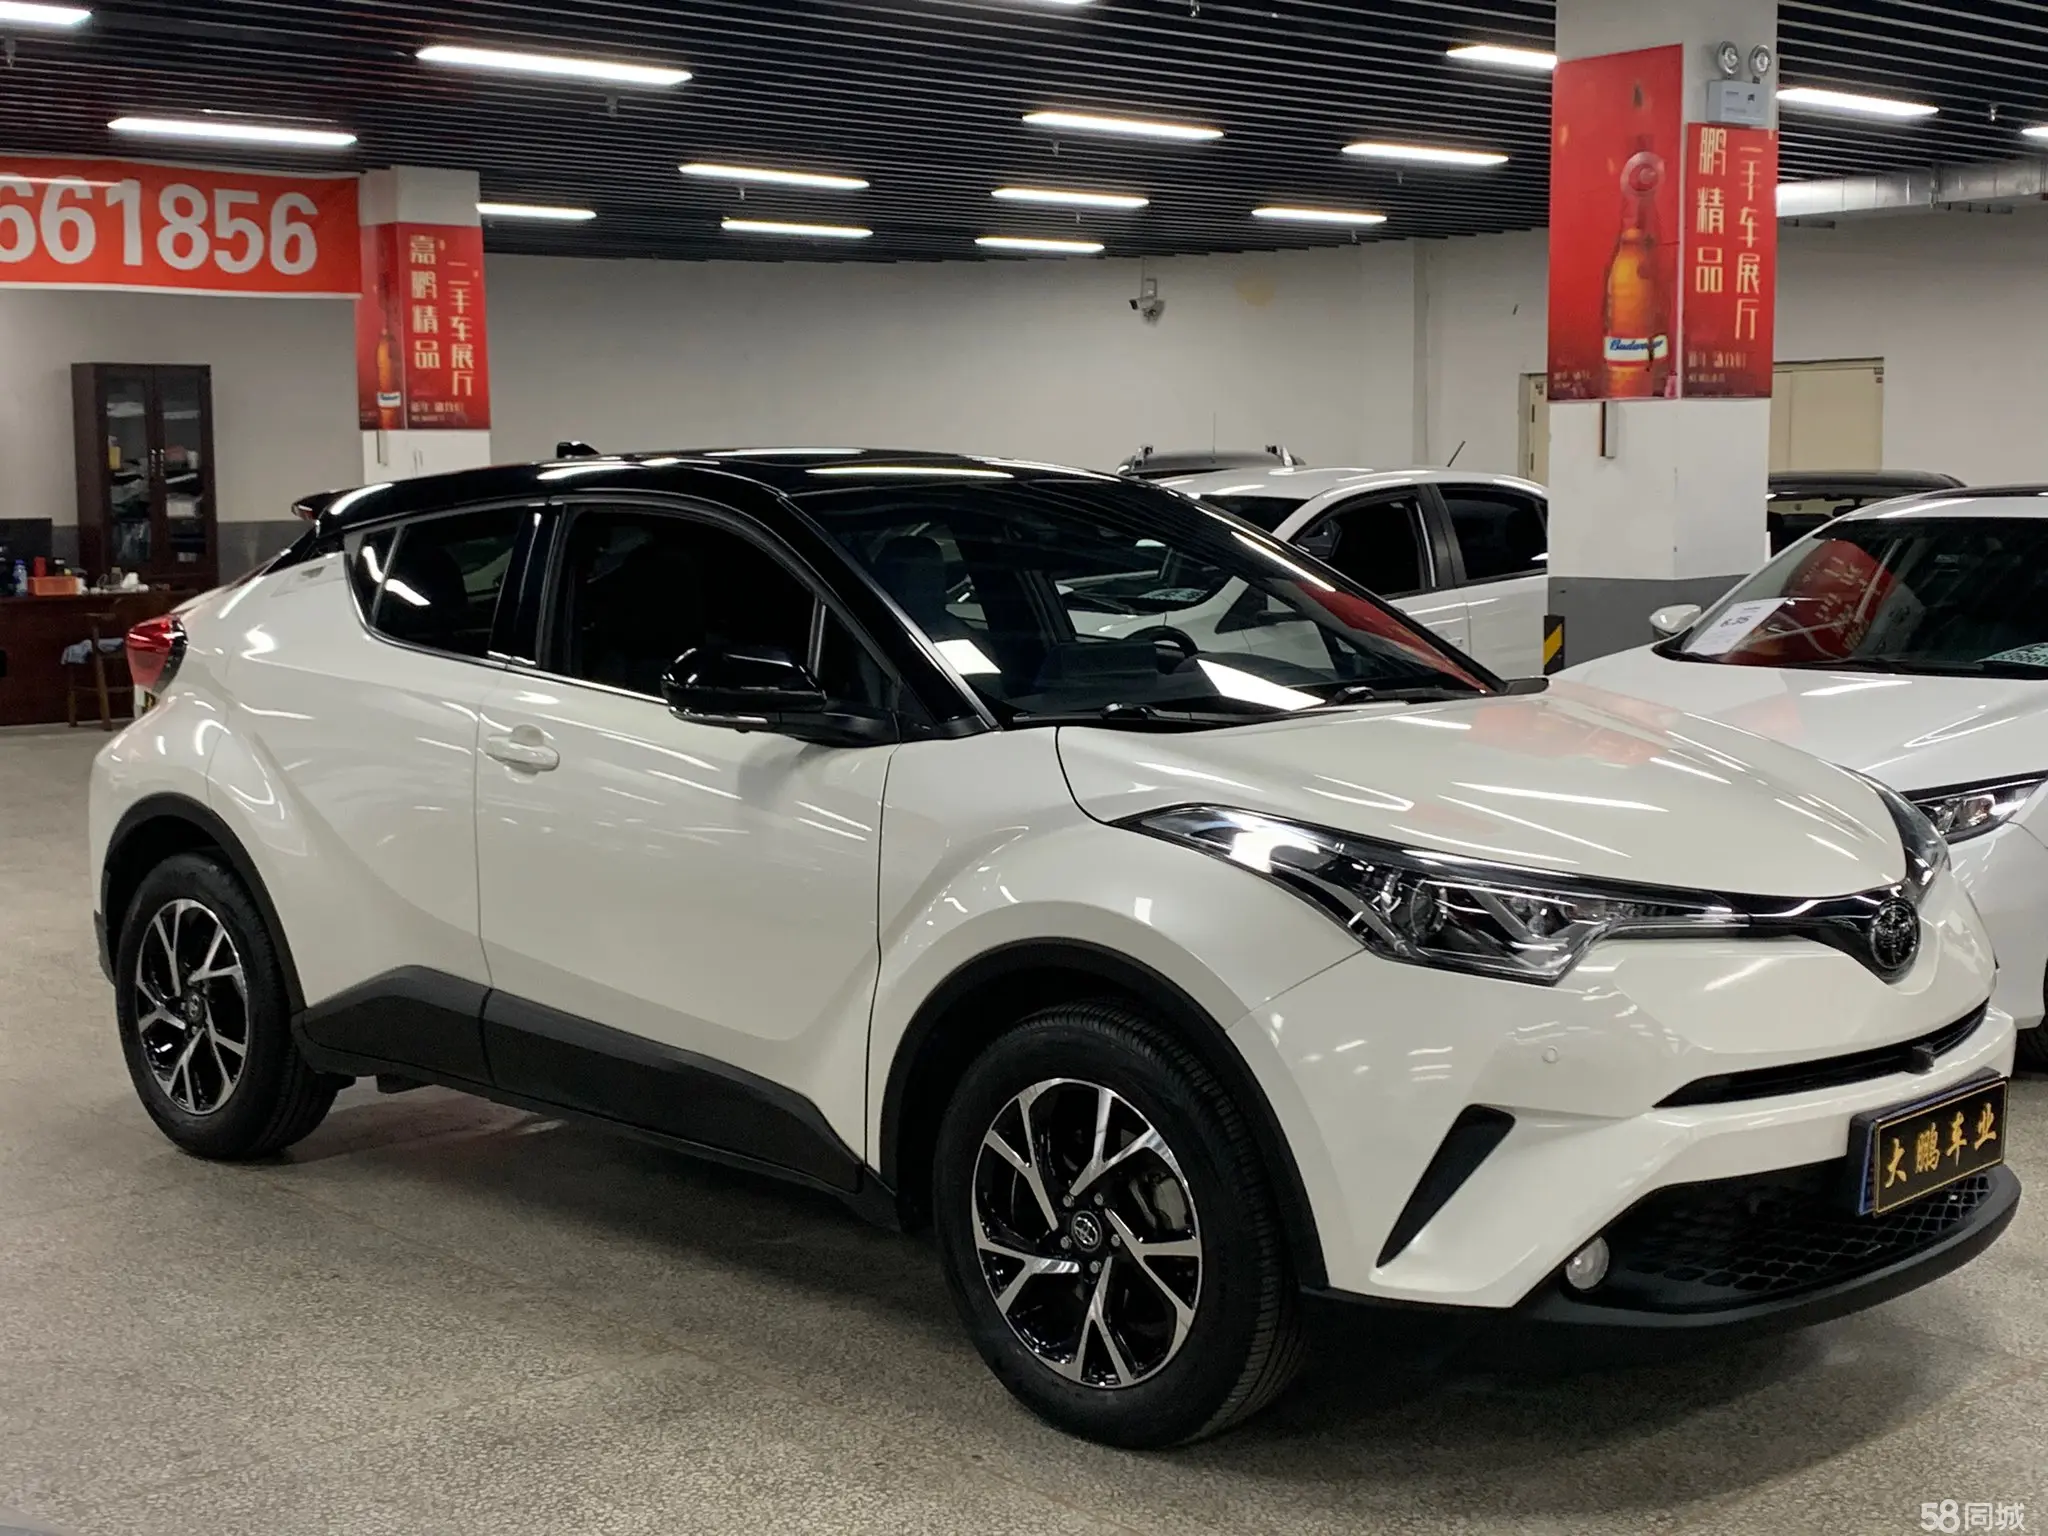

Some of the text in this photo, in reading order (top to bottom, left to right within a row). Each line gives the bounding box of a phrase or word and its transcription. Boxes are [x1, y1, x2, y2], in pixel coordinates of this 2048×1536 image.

[0, 172, 319, 275] 661856
[410, 235, 441, 370] 嘉鹏精品
[447, 261, 476, 396] 二手车展厅
[1884, 1102, 1998, 1189] 大鹏车业
